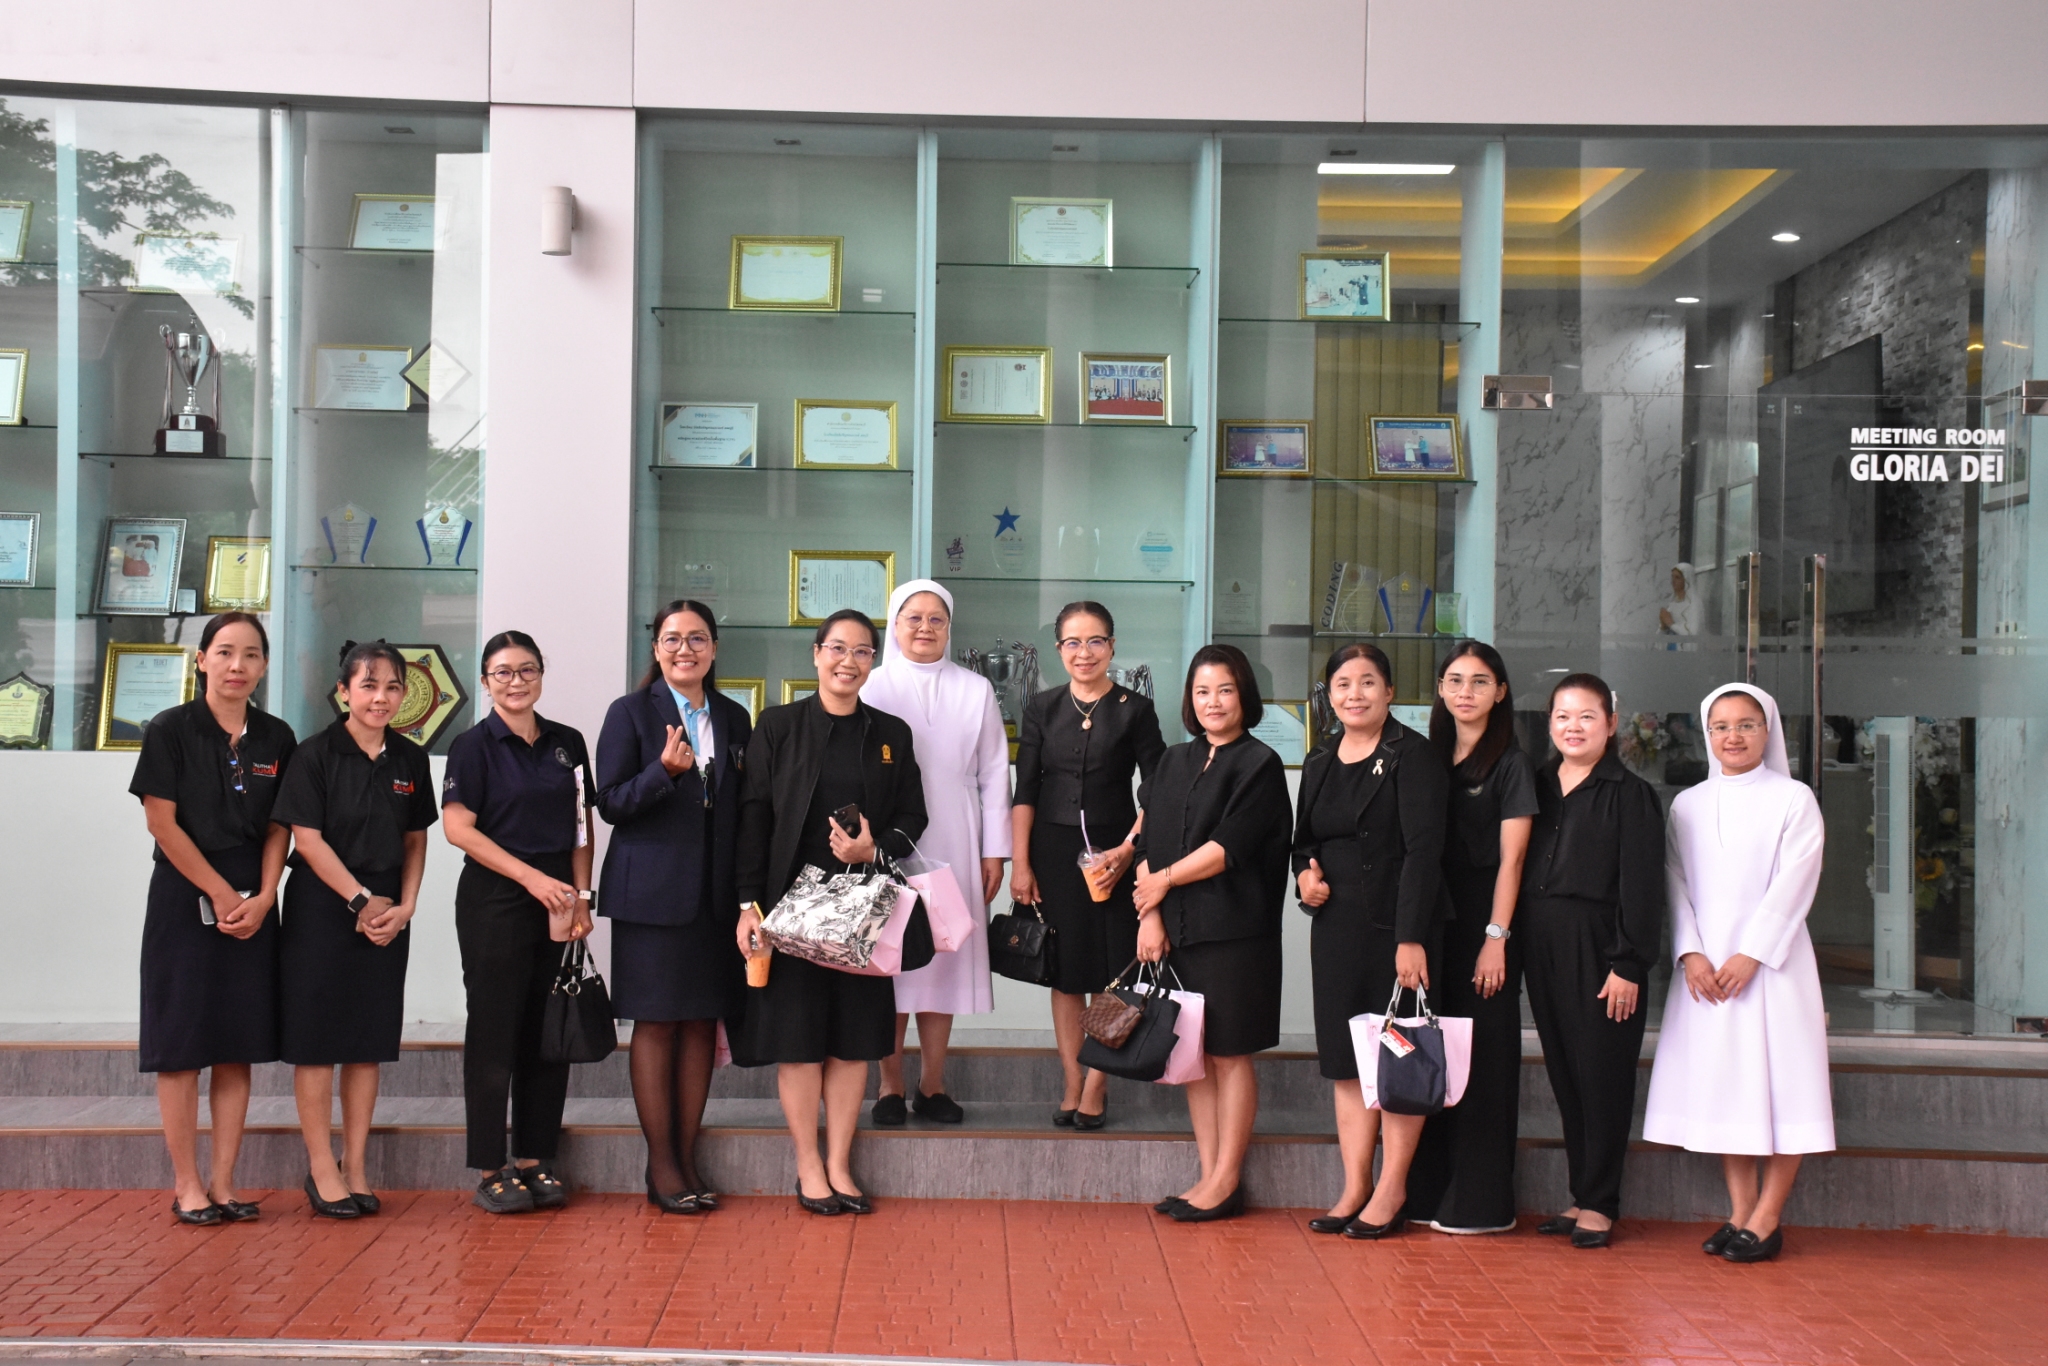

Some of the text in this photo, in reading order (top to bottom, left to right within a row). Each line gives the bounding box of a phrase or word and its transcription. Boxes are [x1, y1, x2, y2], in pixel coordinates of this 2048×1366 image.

[1851, 427, 2005, 445] MEETING ROOM
[1850, 454, 2004, 482] GLORIA DEI
[1321, 561, 1343, 628] CODING
